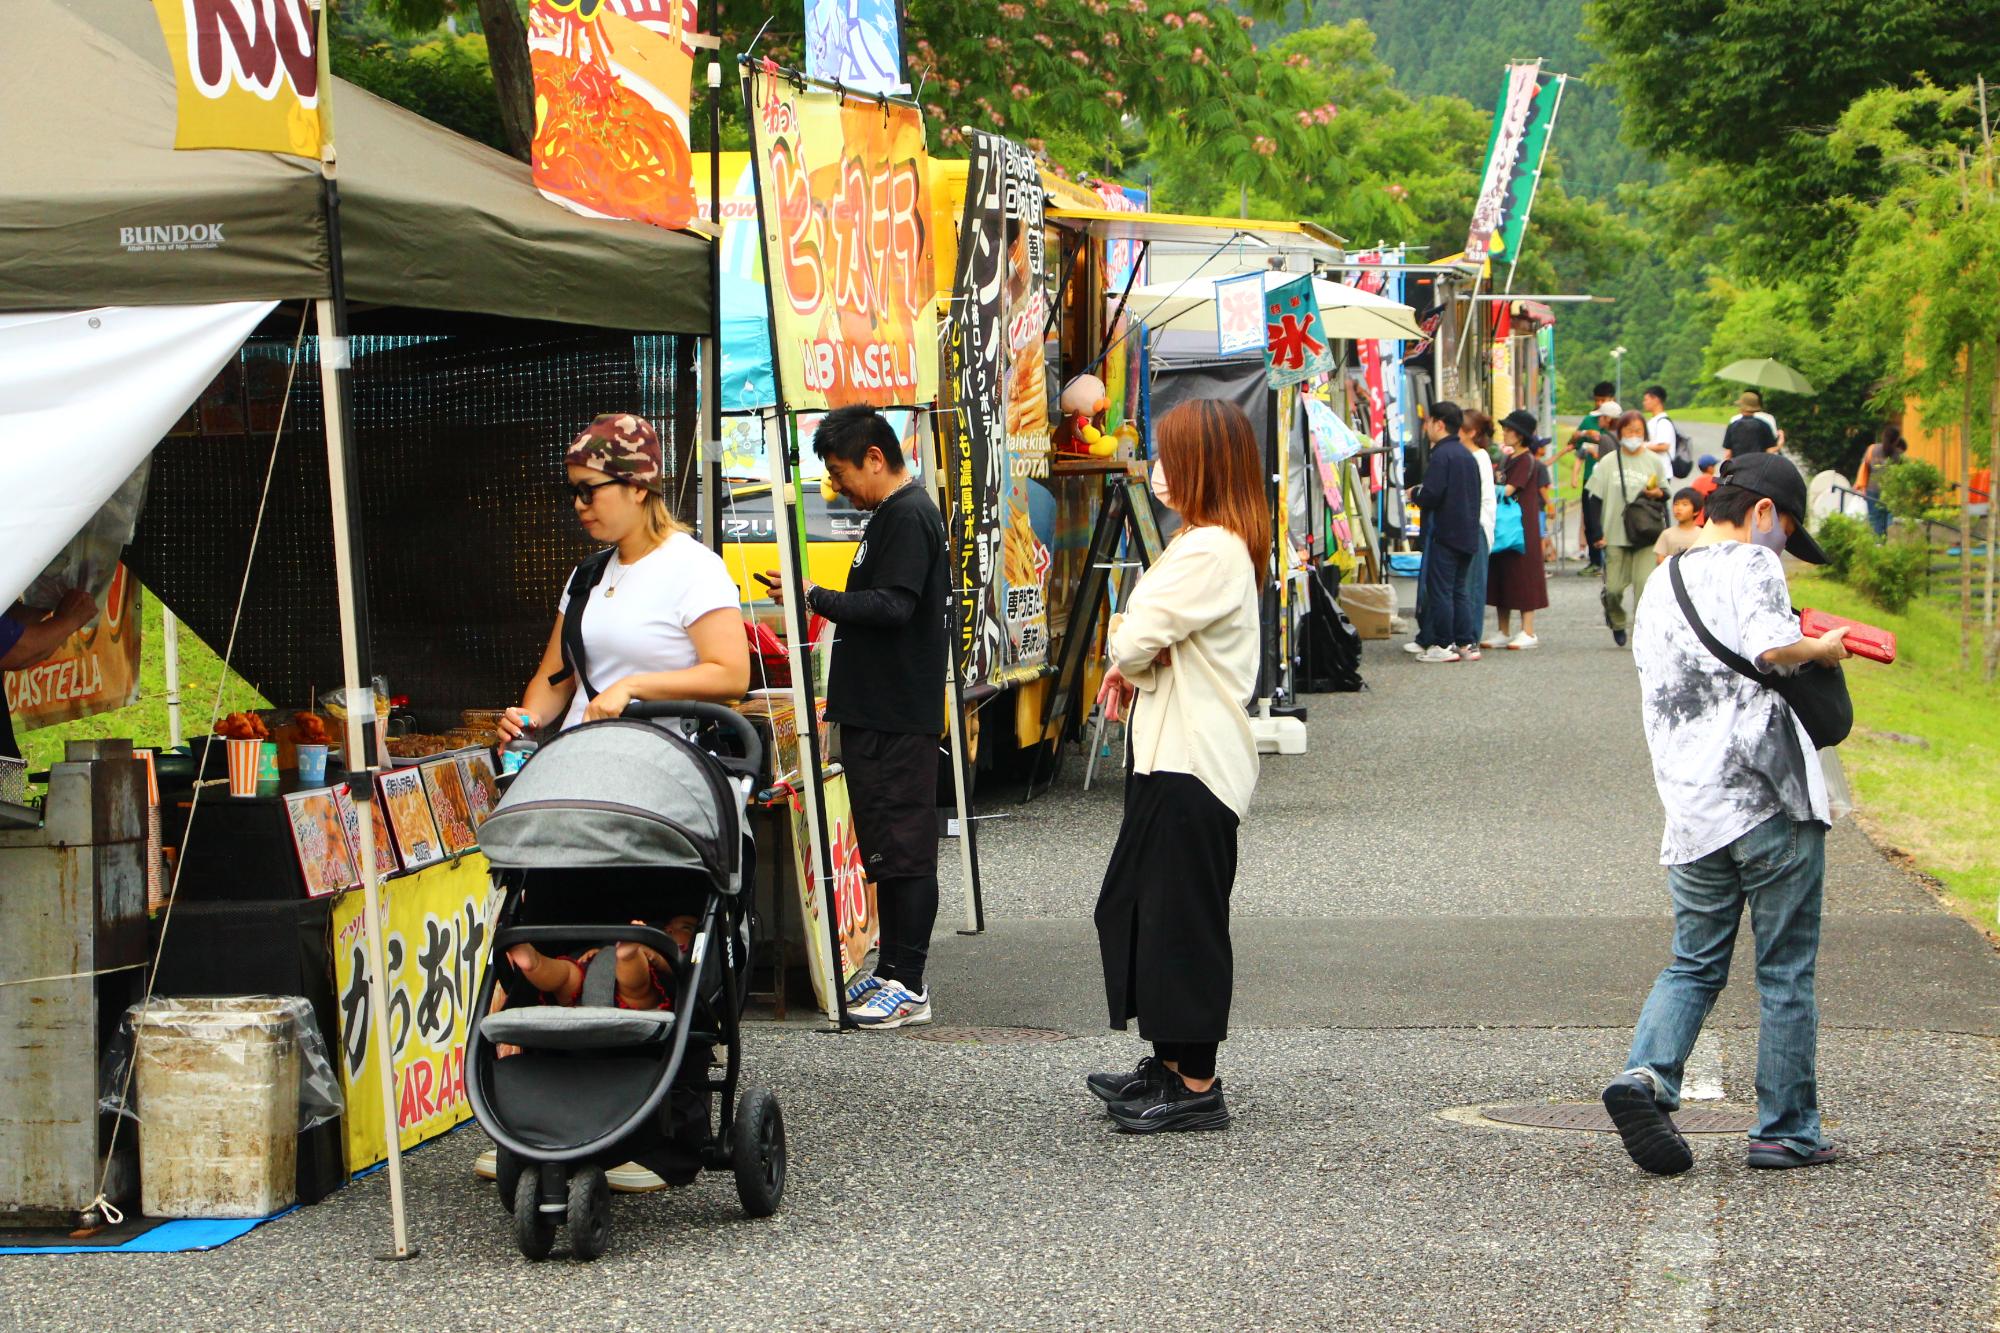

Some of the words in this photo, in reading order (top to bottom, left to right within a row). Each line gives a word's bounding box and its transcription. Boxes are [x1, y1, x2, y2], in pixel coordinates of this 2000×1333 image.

[119, 223, 225, 246] BUNDOK
[145, 243, 155, 251] the
[1266, 312, 1326, 370] 氷
[4, 654, 103, 712] CASTELLA
